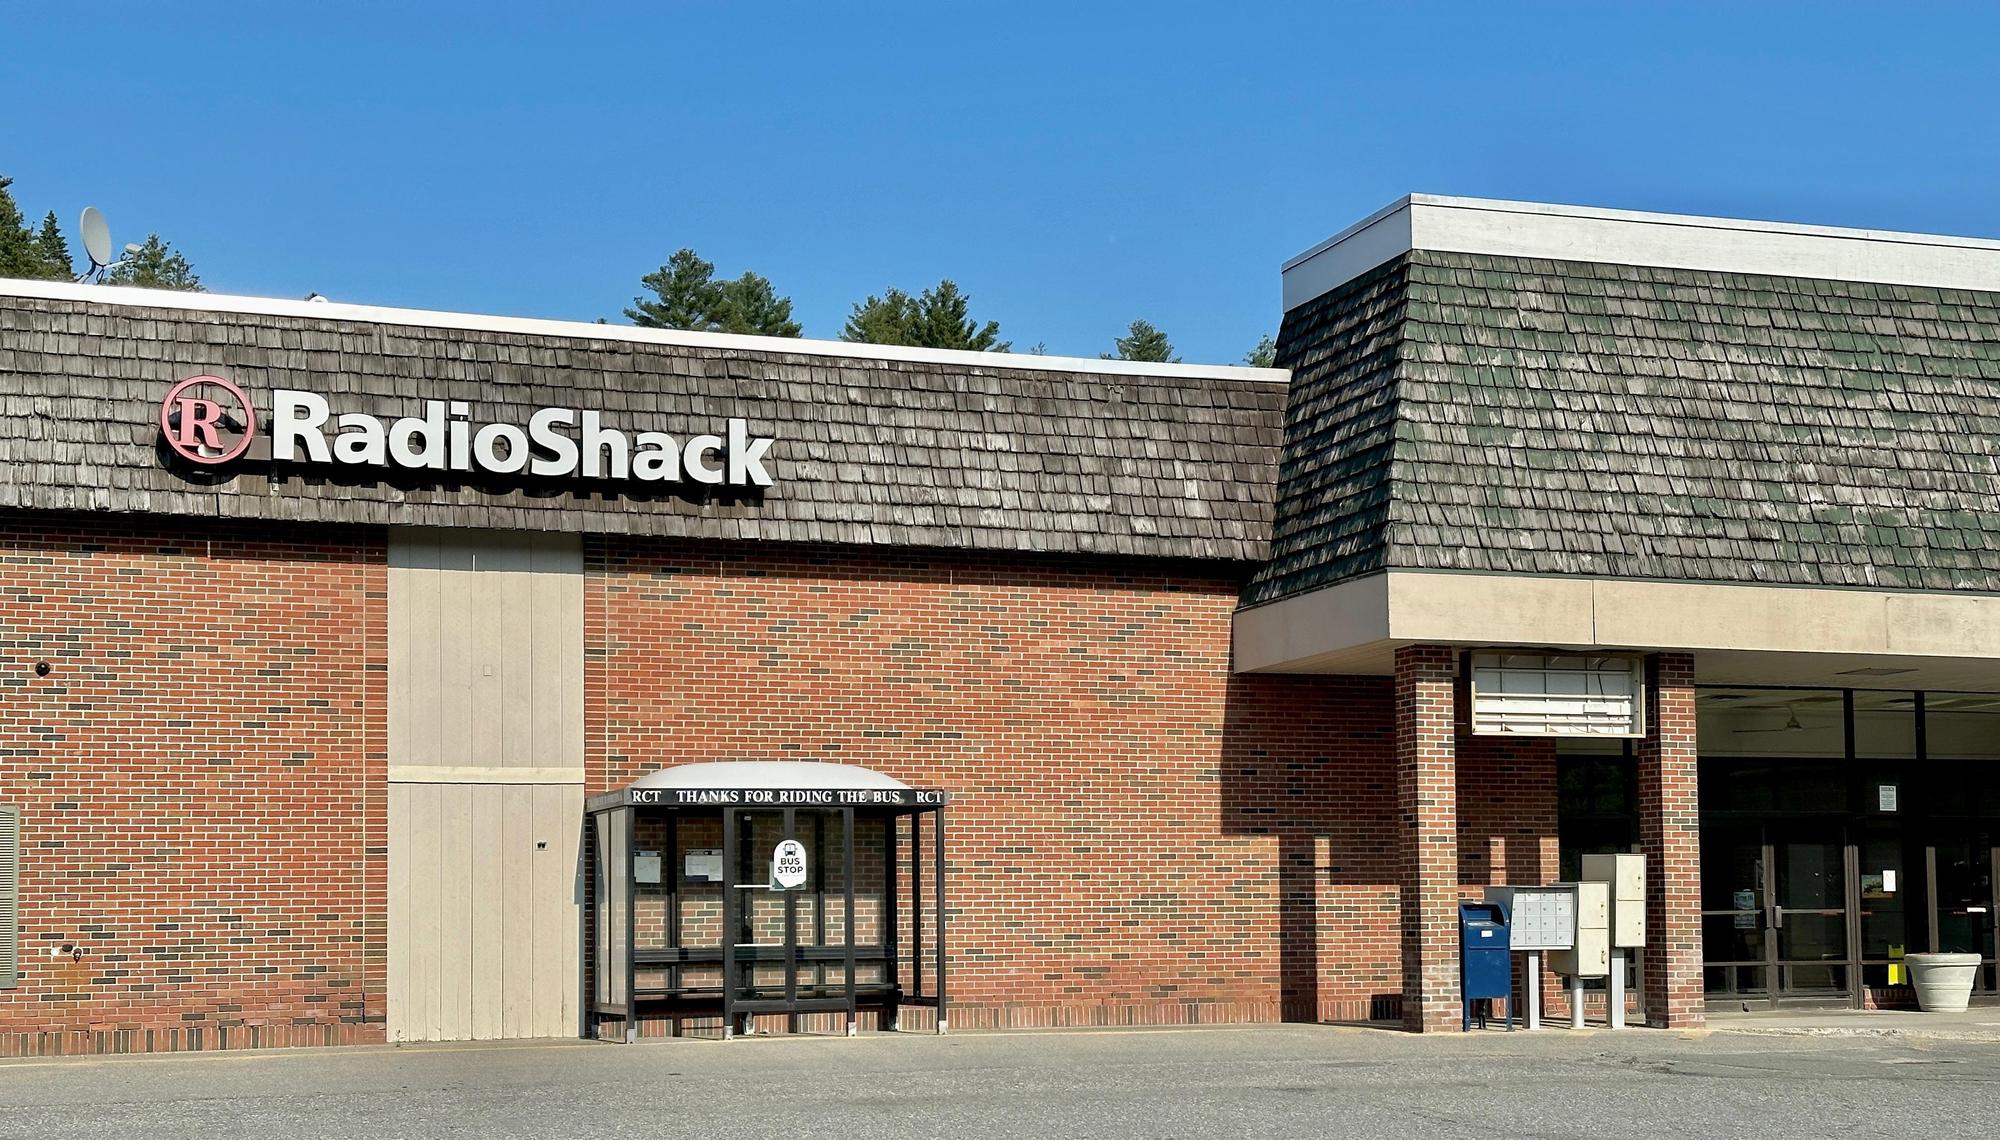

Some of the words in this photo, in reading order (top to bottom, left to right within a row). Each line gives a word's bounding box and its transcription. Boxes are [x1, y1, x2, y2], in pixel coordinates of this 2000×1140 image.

[272, 389, 774, 487] RadioShack
[631, 790, 661, 803] RCT
[676, 790, 739, 803] THANKS
[744, 790, 773, 803] FOR
[779, 790, 832, 804] RIDING
[837, 790, 868, 803] THE
[873, 790, 900, 803] BUS
[916, 791, 943, 804] RCT
[780, 857, 801, 866] BUS
[777, 866, 804, 874] STOP
